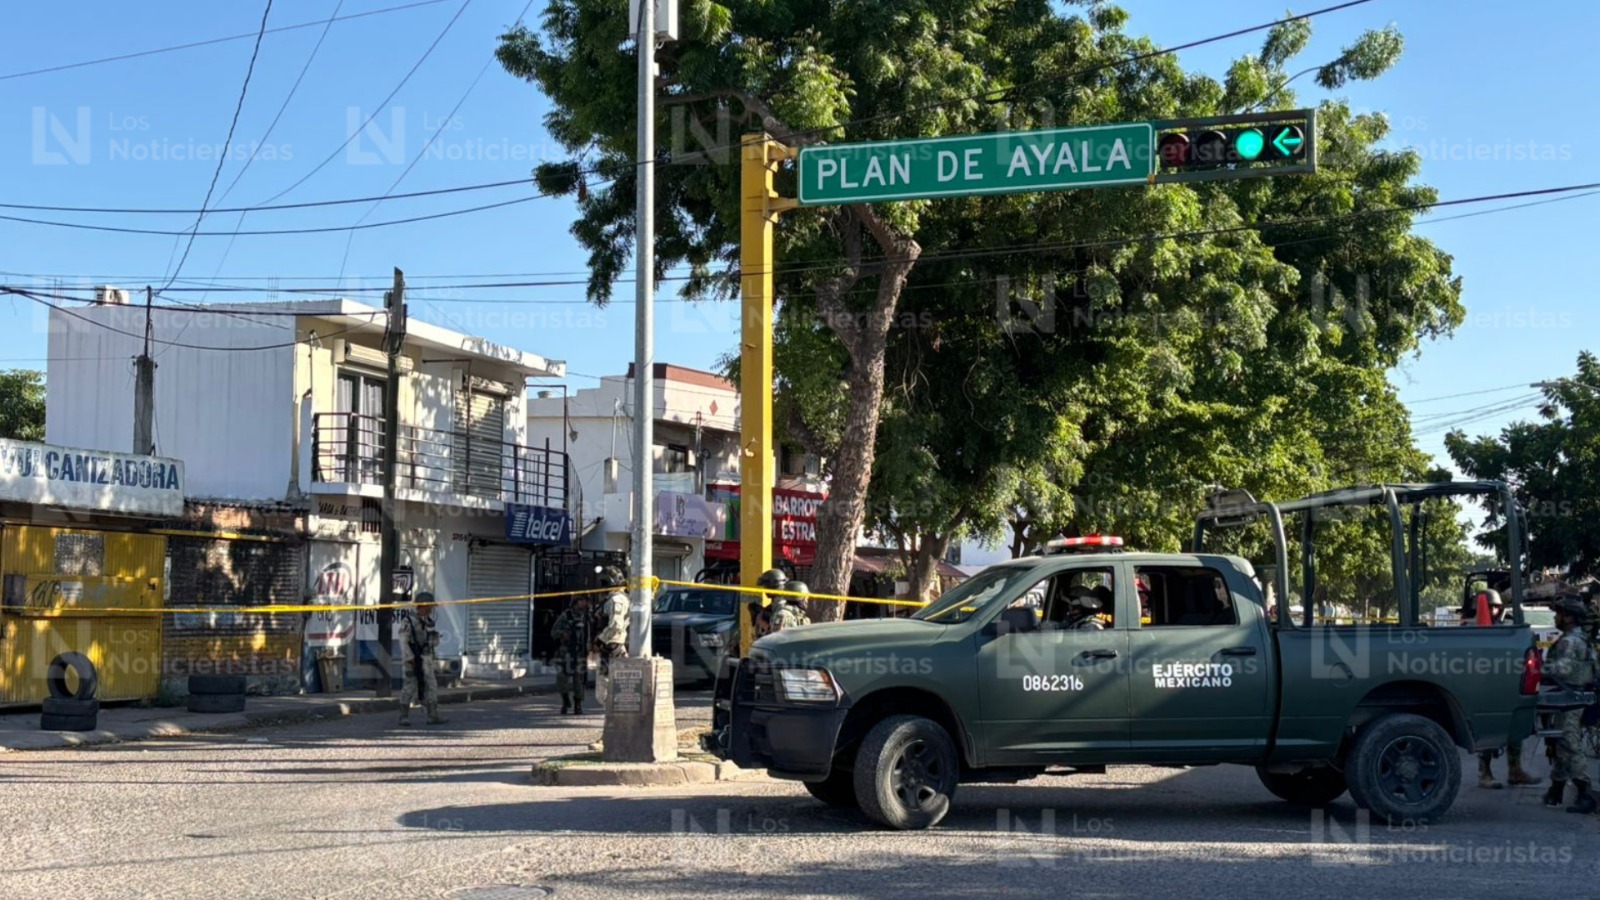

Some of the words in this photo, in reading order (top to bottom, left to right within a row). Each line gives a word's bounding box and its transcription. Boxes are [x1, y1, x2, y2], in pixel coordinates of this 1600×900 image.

[817, 153, 911, 190] PLAN
[937, 147, 984, 182] DE
[1006, 138, 1133, 178] AYALA
[1, 445, 180, 491] VULCANIZADORA
[772, 495, 824, 517] BARROT
[525, 513, 565, 541] telcel
[1152, 661, 1233, 677] EJÉRCITO
[1022, 674, 1084, 692] 0862316
[1154, 677, 1232, 688] MEXICANO
